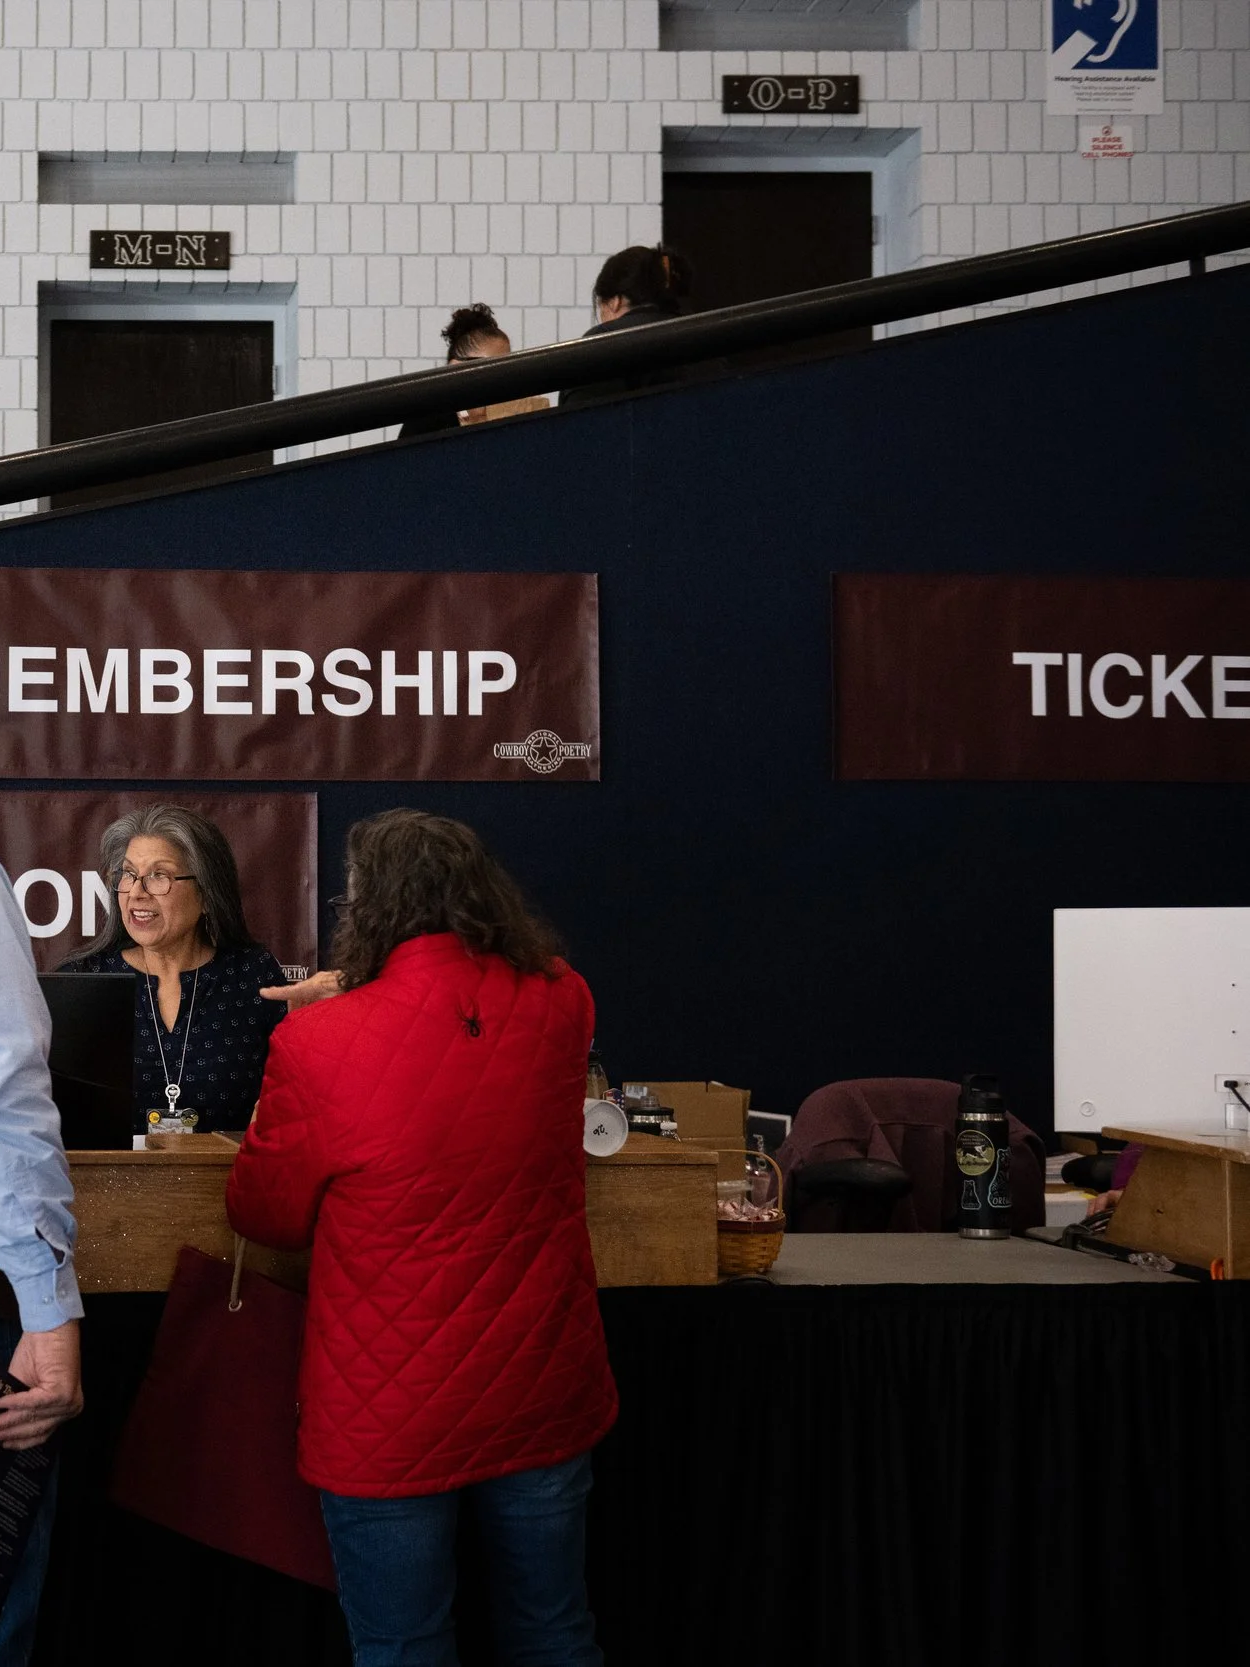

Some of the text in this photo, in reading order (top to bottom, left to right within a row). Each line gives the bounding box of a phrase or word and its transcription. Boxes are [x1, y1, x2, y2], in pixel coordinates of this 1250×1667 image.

[747, 77, 836, 110] O-P
[114, 234, 206, 265] M-N
[1012, 652, 1250, 719] TICKE
[527, 731, 560, 745] NATIONAL
[493, 743, 592, 758] COWBOY POETRY
[526, 757, 562, 771] GATHERING
[282, 967, 309, 979] OETRY
